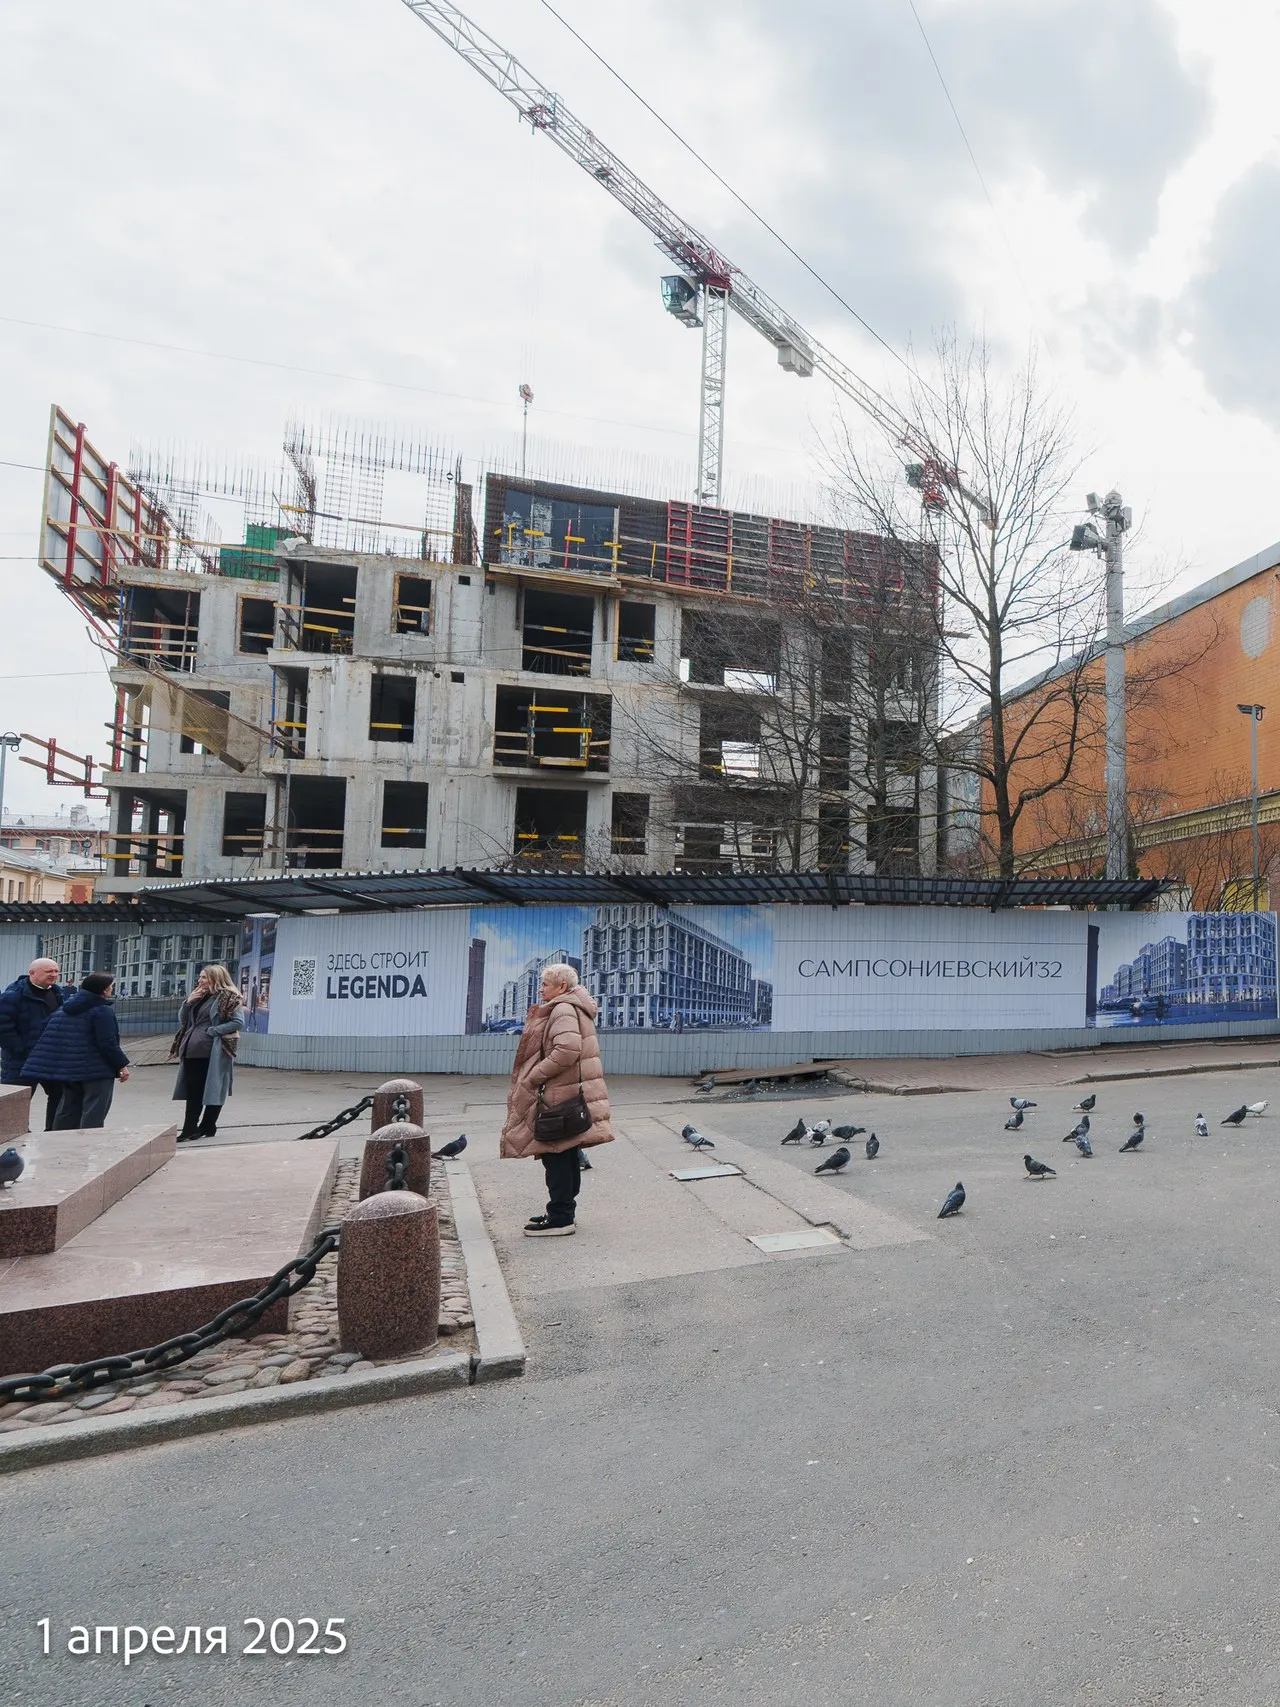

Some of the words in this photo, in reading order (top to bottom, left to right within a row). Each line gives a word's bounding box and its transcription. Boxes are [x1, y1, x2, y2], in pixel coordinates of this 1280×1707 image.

[326, 953, 367, 973] ЗДЕСЬ
[370, 951, 429, 970] СТРОИТ
[326, 973, 428, 1000] LEGENDA
